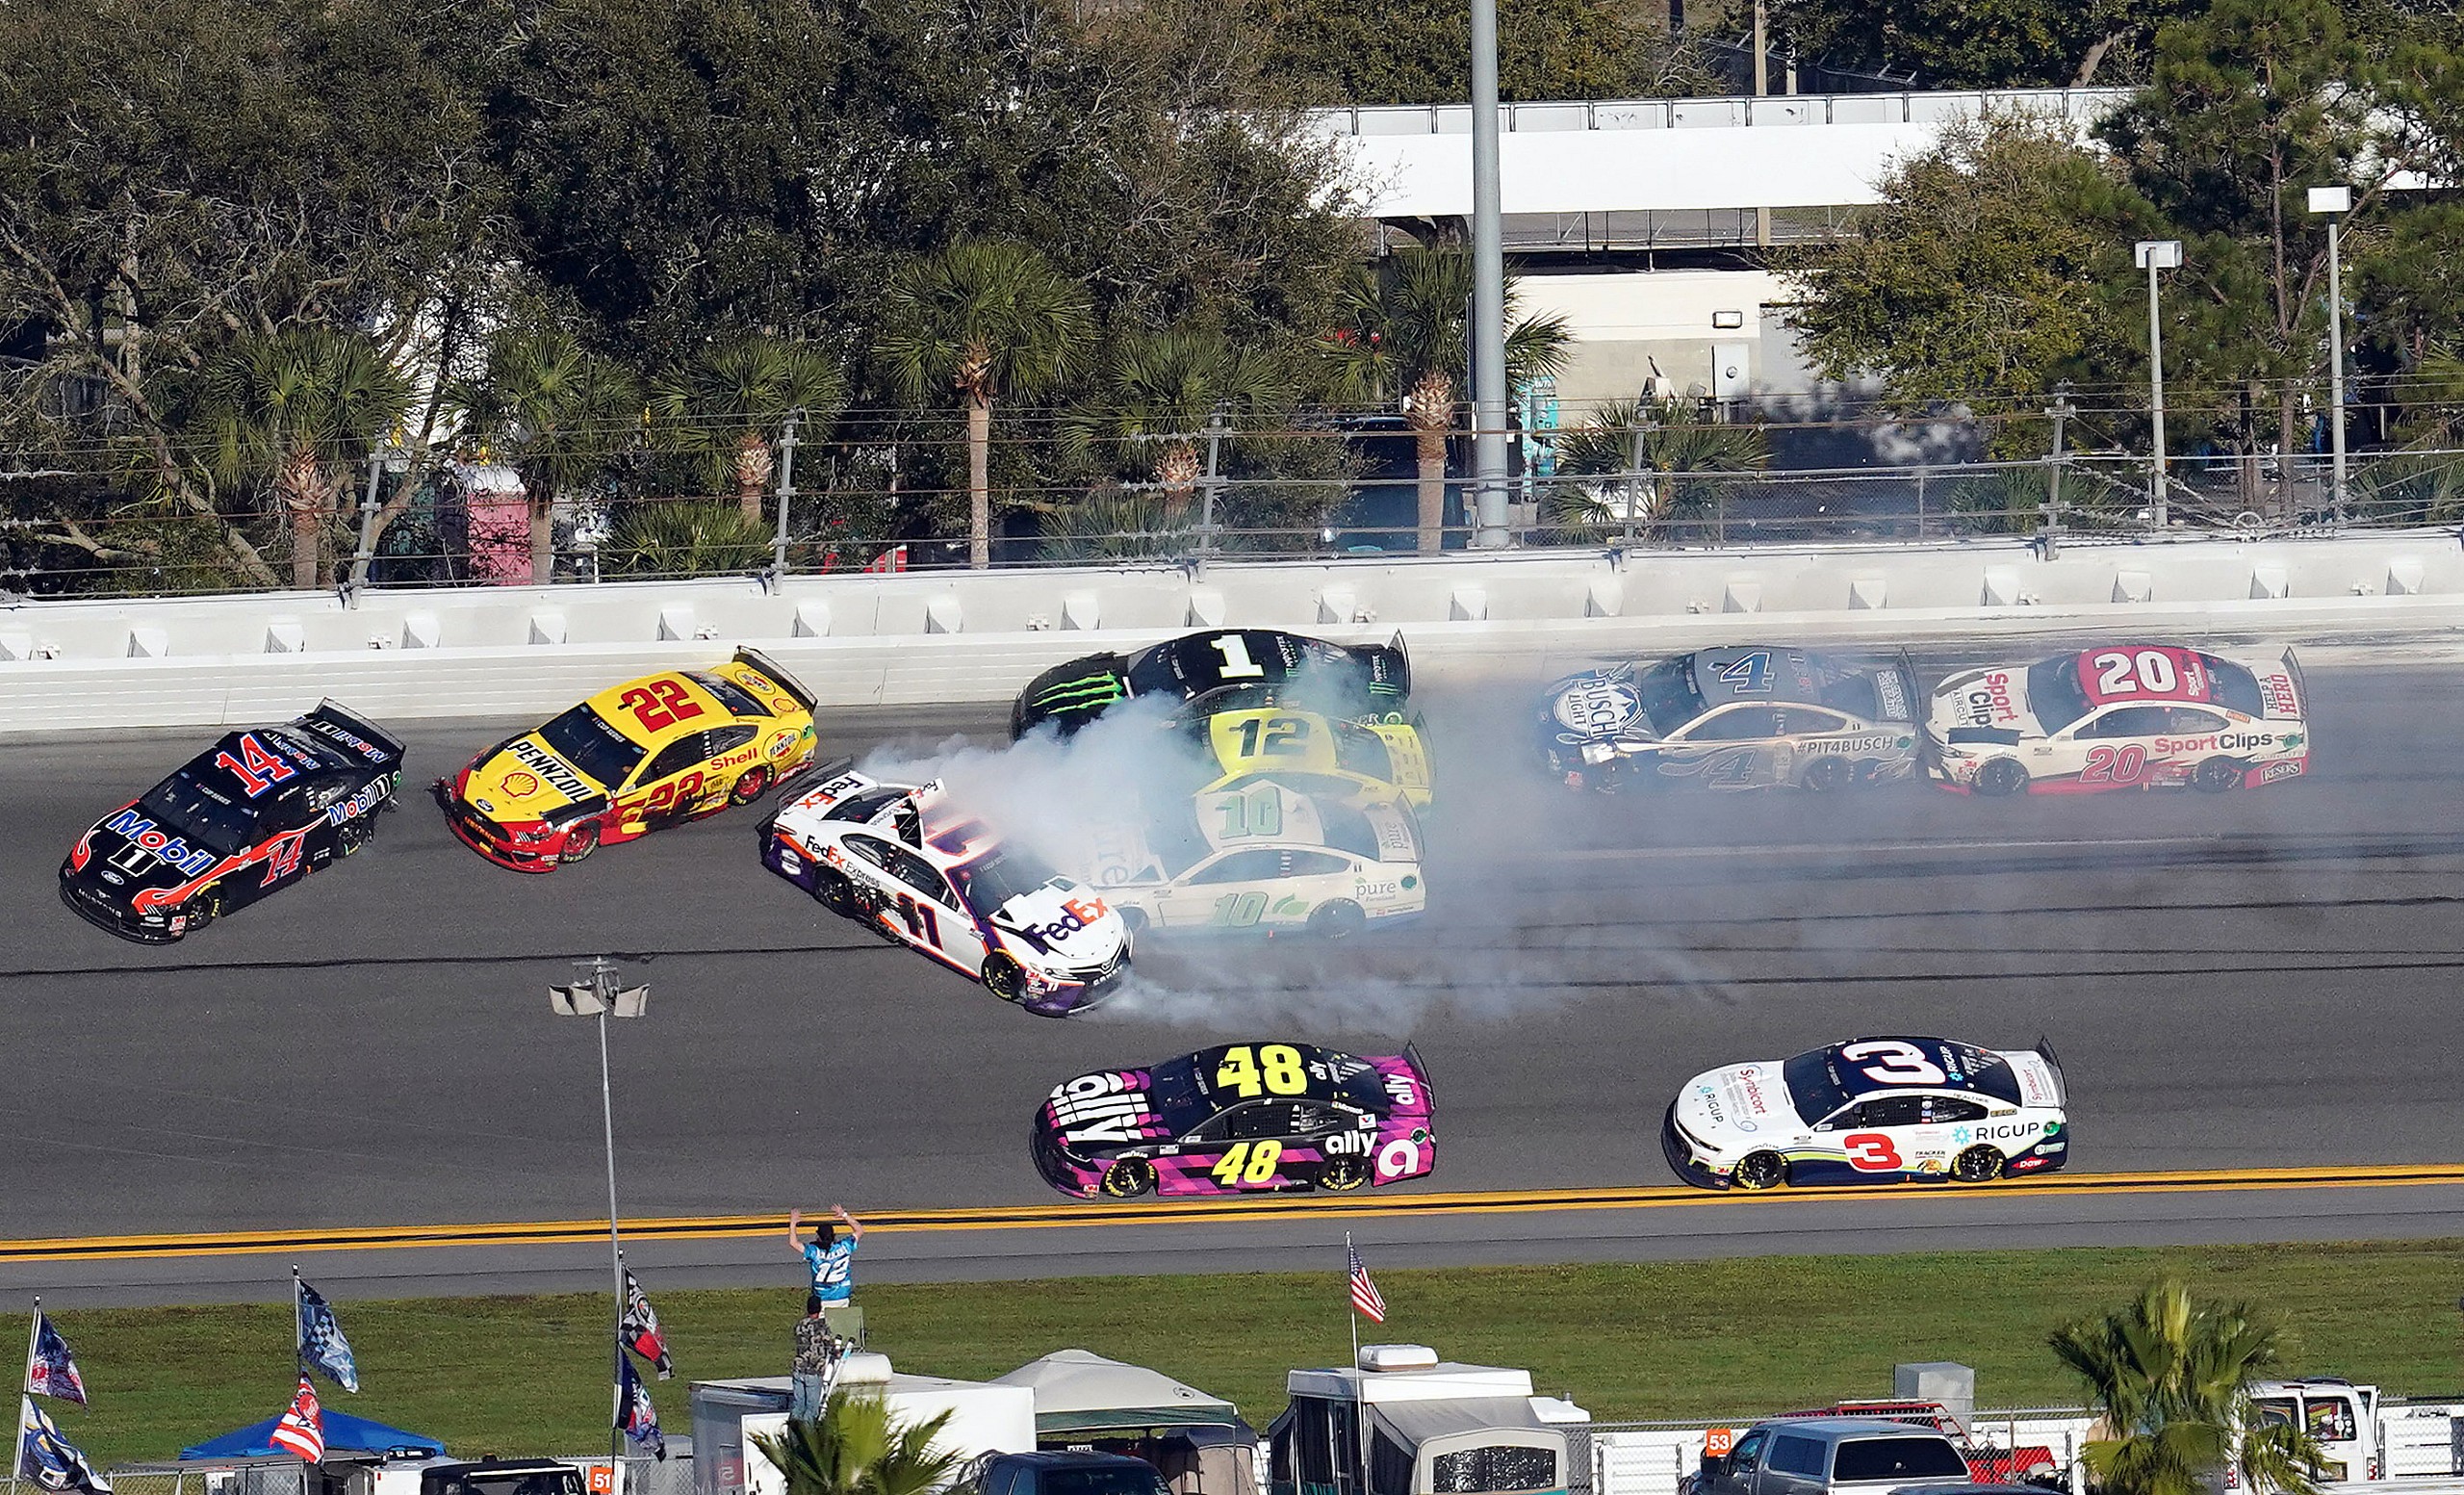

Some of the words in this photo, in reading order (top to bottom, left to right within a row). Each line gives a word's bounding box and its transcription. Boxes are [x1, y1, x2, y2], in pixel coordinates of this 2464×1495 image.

[1211, 634, 1265, 678] 1
[1719, 650, 1777, 694] 4
[2092, 650, 2177, 695] 20
[621, 680, 705, 734] 22
[1567, 693, 1586, 725] LIGHT
[1579, 678, 1619, 737] BUSCH
[1968, 691, 1994, 727] Clip
[1987, 673, 2019, 723] Sport
[2270, 675, 2297, 714] HERO
[332, 730, 390, 763] Mobil
[769, 732, 798, 756] PENNZOIL
[1230, 717, 1311, 757] 12
[1798, 736, 1893, 754] #PIT4BUSCH
[215, 733, 298, 799] 14
[507, 740, 594, 803] PENNZOIL
[710, 748, 757, 770] Shell
[2079, 743, 2147, 783] 20
[326, 784, 376, 827] Mobil
[797, 776, 864, 810] FedEx
[1216, 786, 1282, 838] 10
[106, 809, 217, 878] Mobil
[259, 833, 305, 889] 14
[805, 834, 846, 868] FedEx
[1213, 891, 1270, 927] 10
[1355, 881, 1397, 899] pure
[1022, 897, 1110, 957] FedEx
[1217, 1044, 1308, 1097] 48
[1309, 1060, 1327, 1081] ally
[1842, 1040, 1946, 1085] 3
[1938, 1045, 1958, 1073] RIGUP
[1385, 1073, 1416, 1105] ally
[1704, 1093, 1724, 1123] RIGUP
[1325, 1131, 1377, 1157] ally
[1976, 1122, 2040, 1141] RIGUP
[1212, 1140, 1283, 1185] 48
[1845, 1133, 1904, 1173] 3
[816, 1255, 850, 1282] 12
[1709, 1434, 1730, 1450] 53
[594, 1474, 610, 1488] 51
